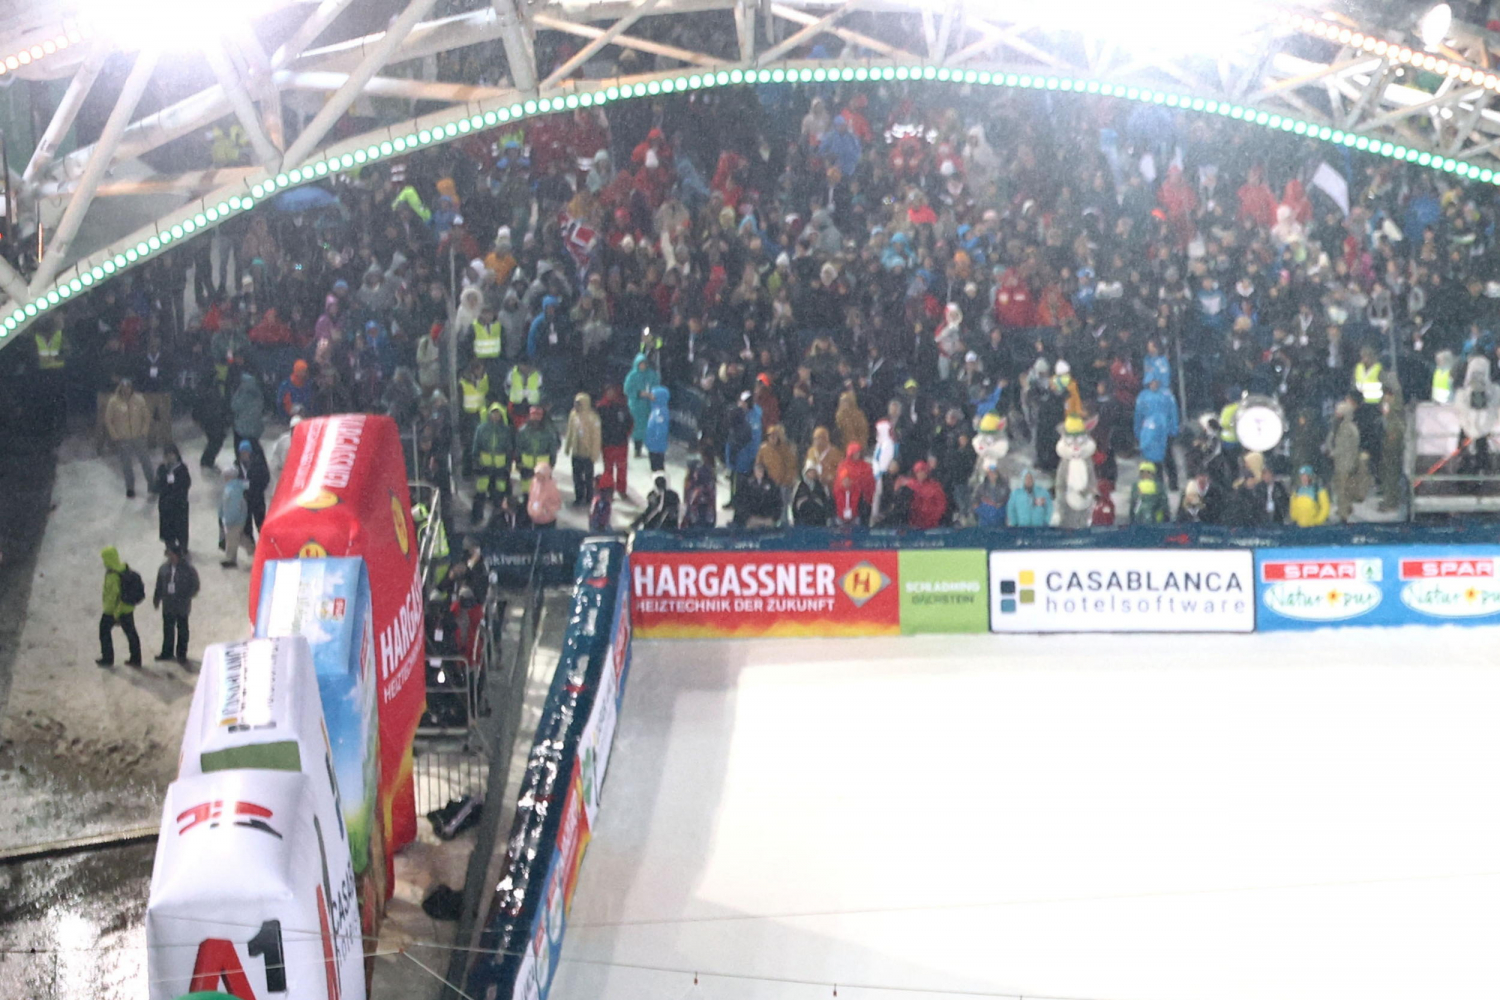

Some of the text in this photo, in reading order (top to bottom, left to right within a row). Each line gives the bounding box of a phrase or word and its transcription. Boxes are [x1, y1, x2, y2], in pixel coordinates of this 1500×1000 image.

[1283, 563, 1355, 580] SPAR
[1421, 561, 1493, 578] SPAR
[634, 563, 836, 598] HARGASSNER
[905, 580, 981, 594] SCHLADMING
[1045, 570, 1244, 593] CASABLANCA
[636, 597, 835, 613] HEIZTECHNIK DER ZUKUNFT
[1045, 594, 1246, 614] hotelsoftware
